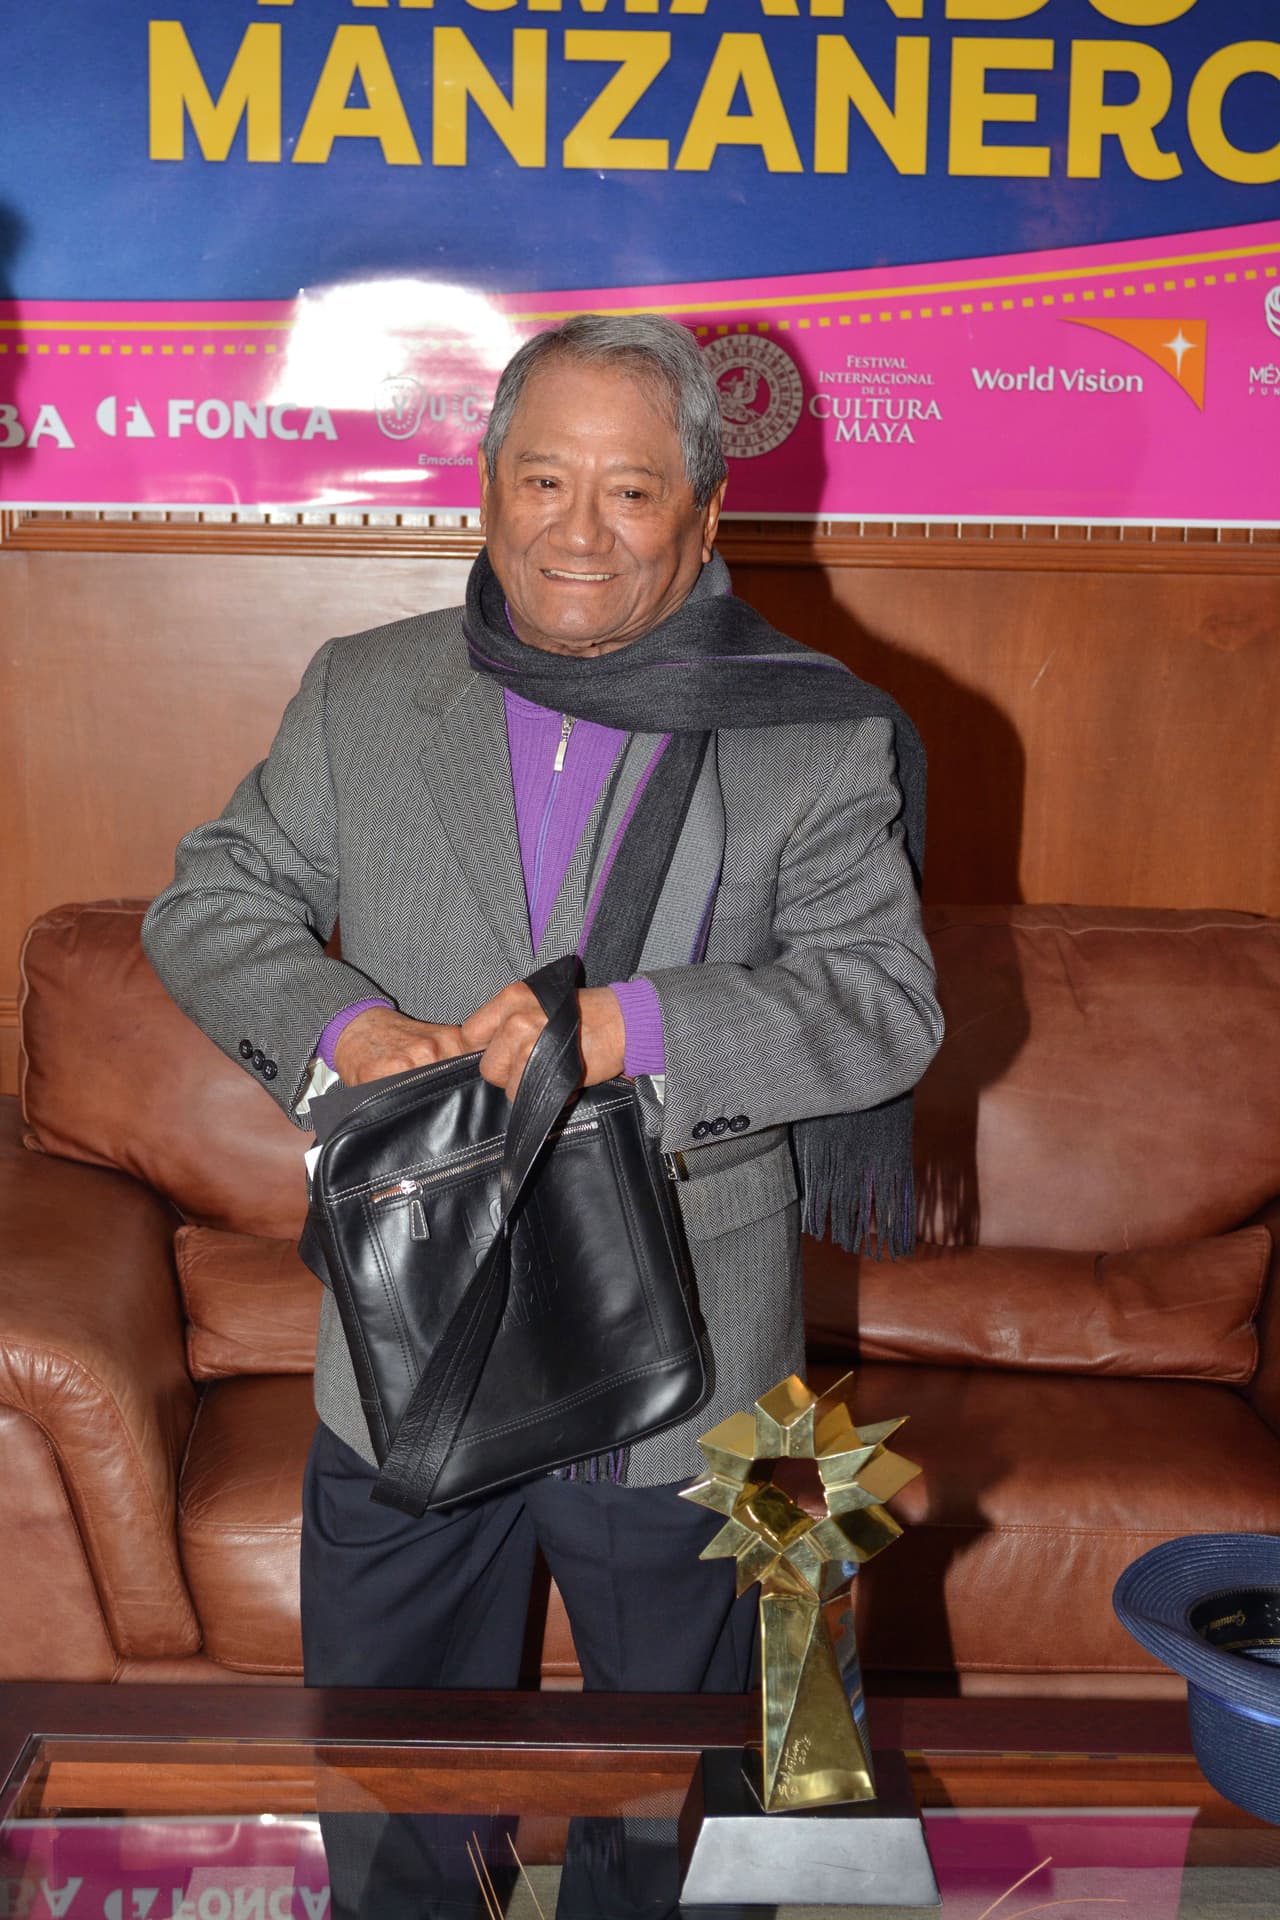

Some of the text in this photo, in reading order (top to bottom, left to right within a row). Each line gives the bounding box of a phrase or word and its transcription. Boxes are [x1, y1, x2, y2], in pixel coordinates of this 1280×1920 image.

[149, 20, 1280, 184] MANZANERO
[846, 354, 907, 368] FESTIVAL
[819, 371, 934, 384] INTERNACIONAL
[971, 365, 1144, 392] World Vision
[862, 386, 890, 395] DE LA
[808, 394, 943, 420] CULTURA
[168, 399, 338, 440] FONCA
[835, 420, 915, 443] MAYA
[417, 454, 473, 465] Emoción
